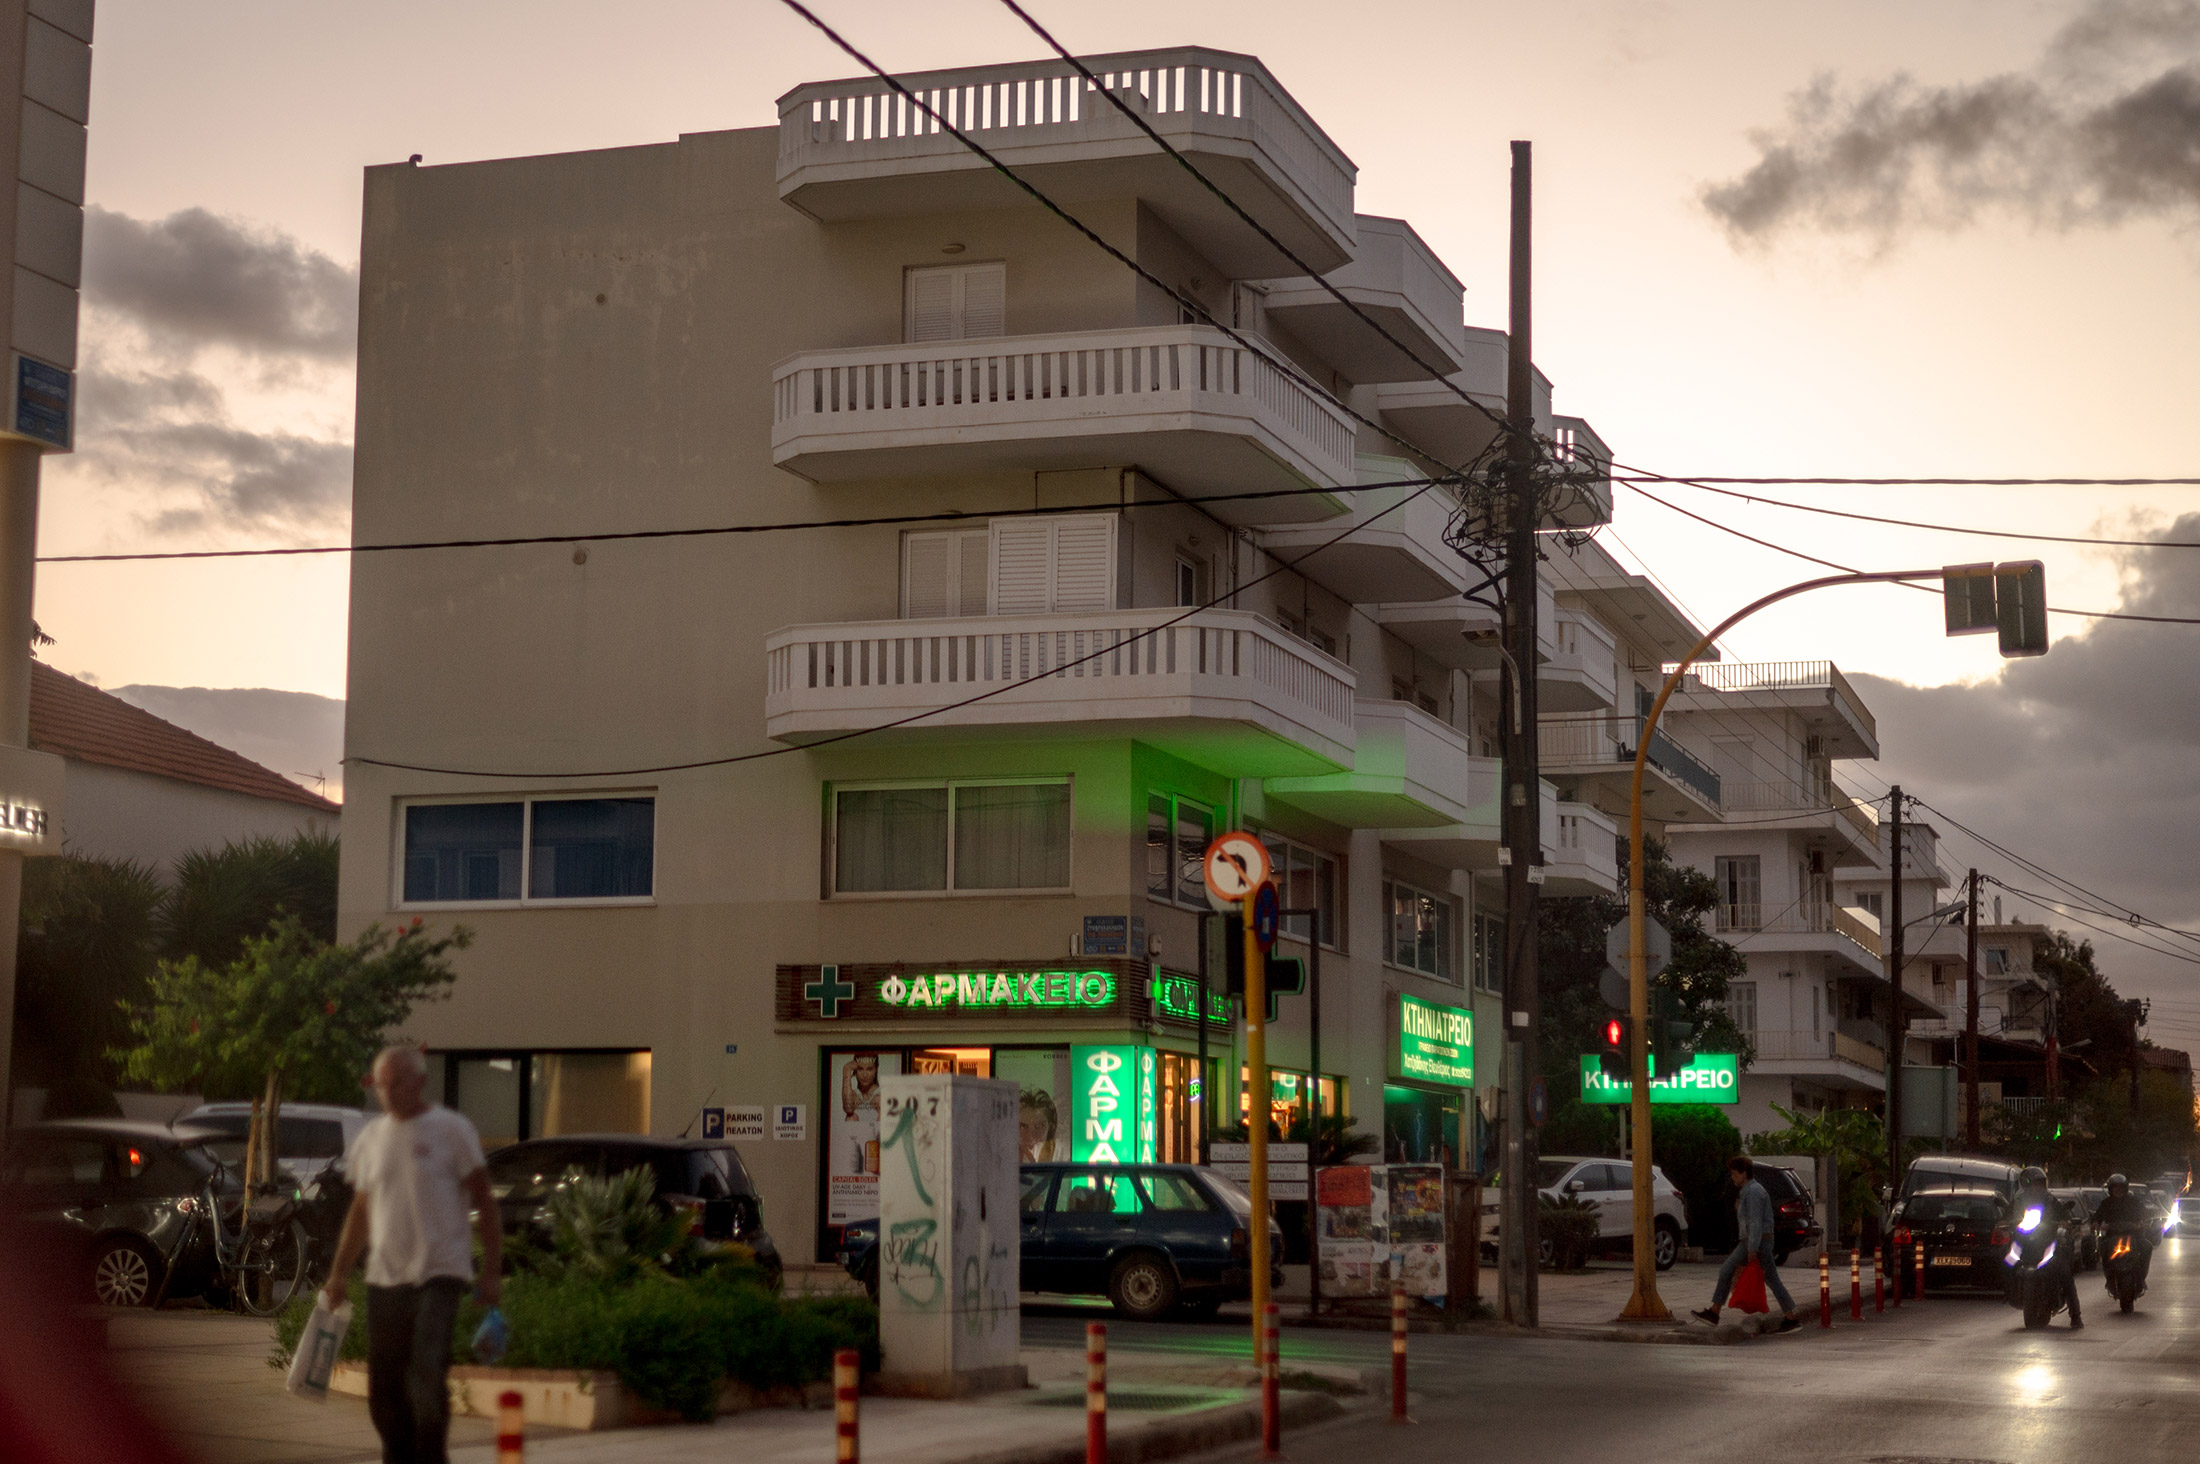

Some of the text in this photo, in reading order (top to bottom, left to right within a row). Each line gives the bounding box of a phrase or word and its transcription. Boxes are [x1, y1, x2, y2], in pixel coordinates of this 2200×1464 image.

[881, 973, 1108, 1007] ΦΑΡΜΑΚΕΙΟ
[1403, 1001, 1472, 1048] ΚΤΗΝΙΑΤΡΕΙΟ
[726, 1113, 763, 1122] PARKING
[726, 1126, 763, 1135] ΠΕΛΑΤΩΝ
